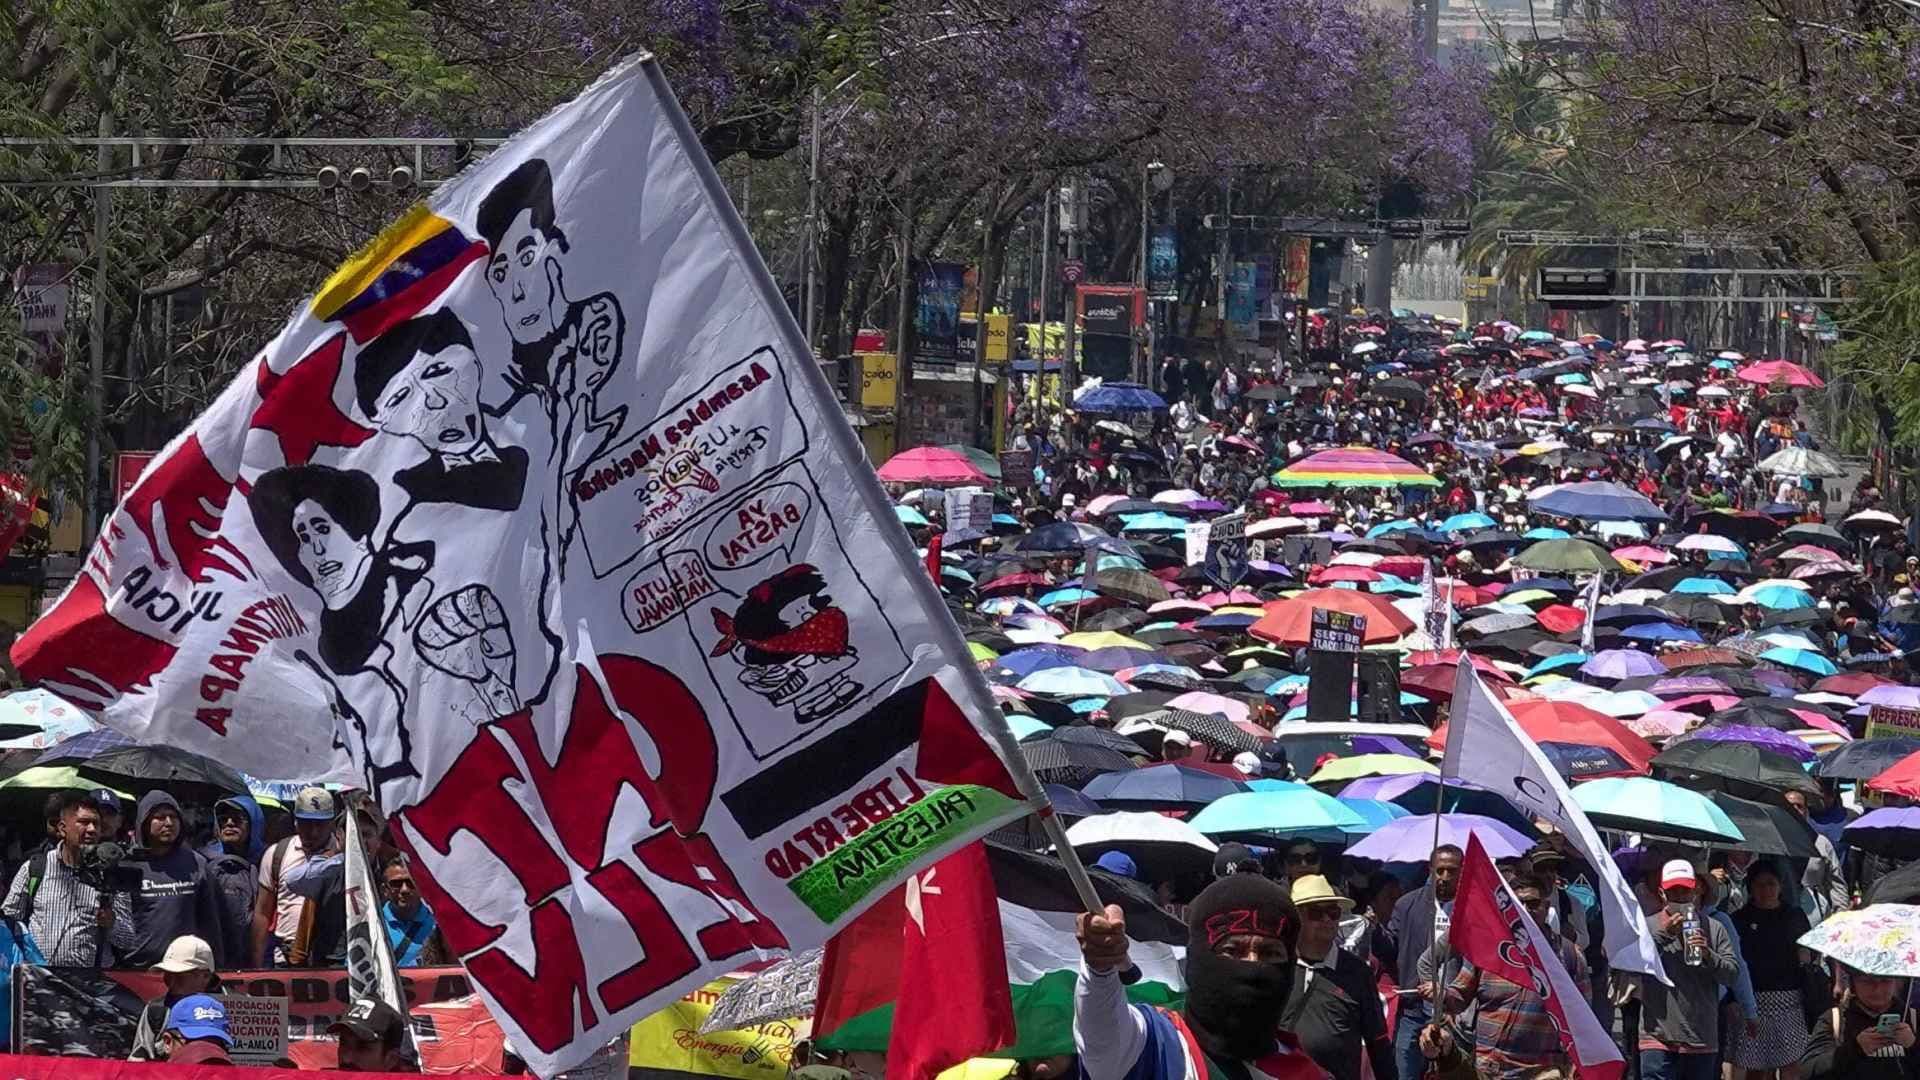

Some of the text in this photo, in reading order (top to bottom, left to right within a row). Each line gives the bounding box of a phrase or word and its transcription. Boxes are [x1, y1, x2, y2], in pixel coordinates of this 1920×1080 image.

[1314, 628, 1360, 645] SECTOR
[224, 999, 280, 1010] BROGACIÓN
[226, 1015, 281, 1026] EFORMA
[224, 1025, 280, 1038] DUCATIVA
[233, 1037, 279, 1051] A-AMLO!
[672, 1028, 745, 1060] Energía
